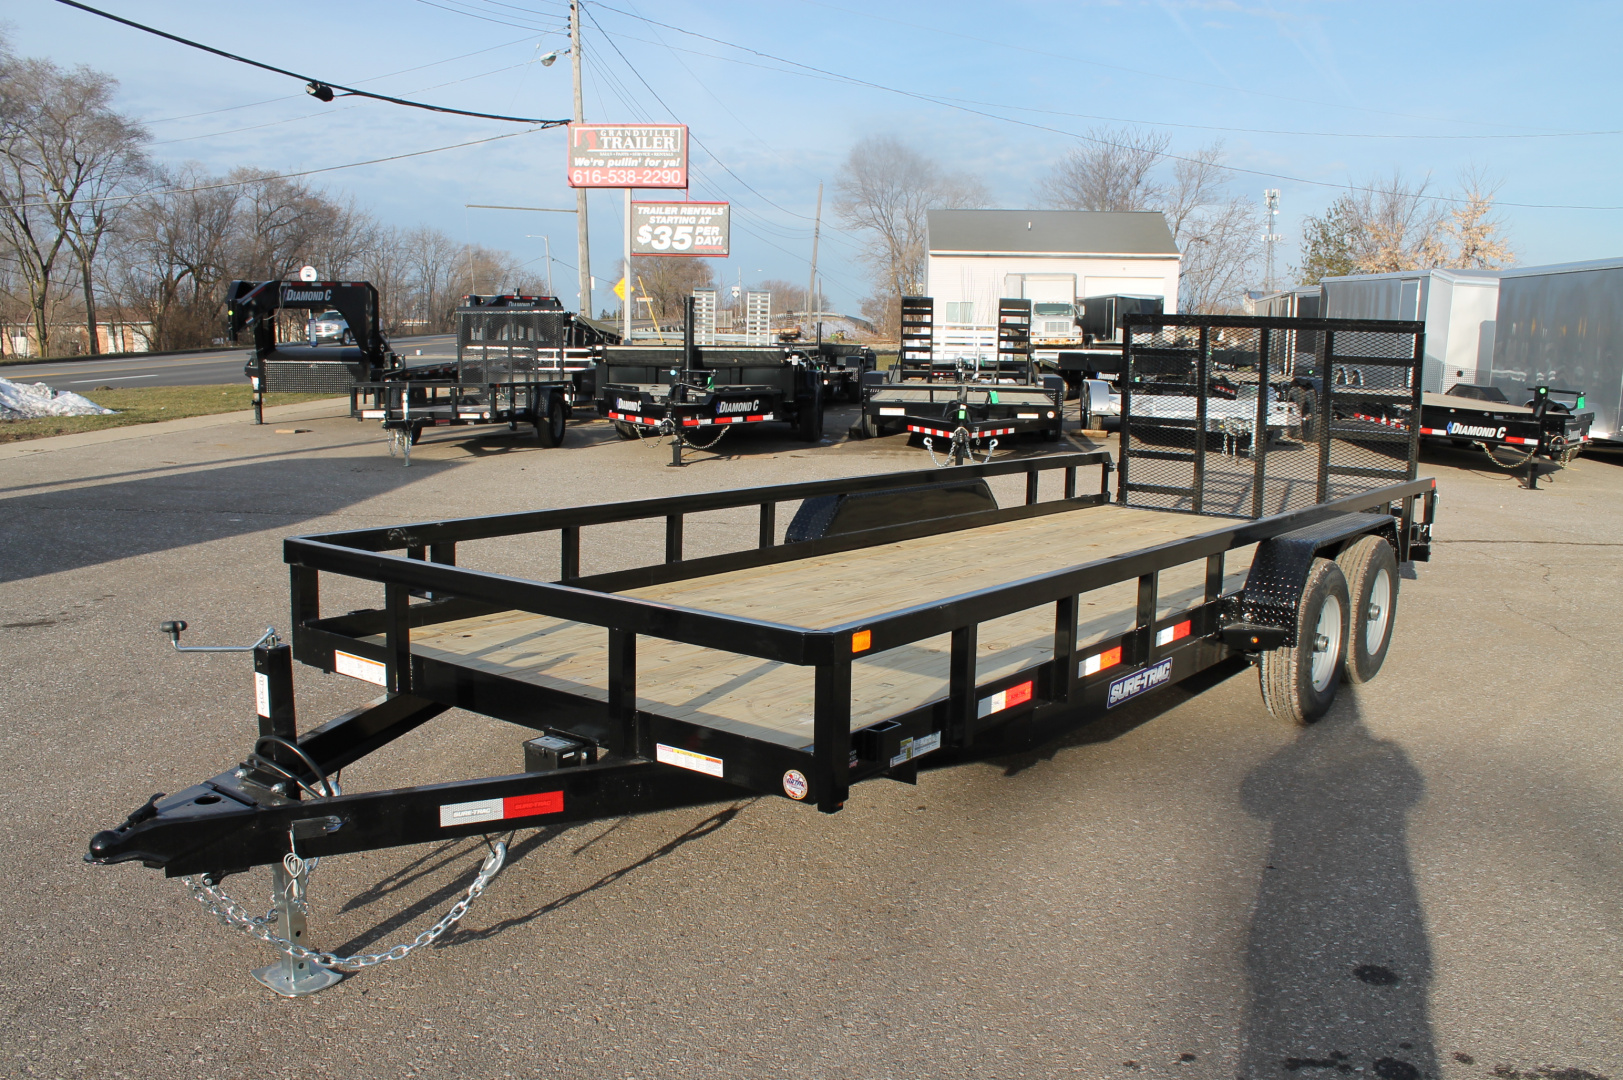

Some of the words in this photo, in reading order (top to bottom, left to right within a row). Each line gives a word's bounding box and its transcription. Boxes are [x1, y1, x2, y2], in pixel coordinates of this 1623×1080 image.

[600, 136, 675, 149] TRAILER
[574, 157, 605, 166] We're
[607, 157, 641, 168] pullin'
[645, 157, 660, 167] for
[663, 158, 681, 168] ya!
[573, 169, 681, 184] 616-538-2290
[637, 206, 678, 215] TRAILER
[680, 207, 724, 215] RENTALS
[649, 216, 696, 224] STARTING
[698, 216, 712, 224] AT
[636, 223, 694, 250] $35
[695, 226, 720, 236] PER
[694, 236, 723, 245] DAY!
[286, 289, 324, 301] DIAMOND
[325, 289, 332, 301] C
[618, 398, 637, 411] DIAMOND
[637, 400, 642, 412] C
[719, 401, 752, 413] DIAMOND
[752, 399, 759, 411] C
[1451, 422, 1496, 437] DIAMOND
[1496, 427, 1507, 438] C
[1110, 663, 1170, 704] SURE-TRAC
[453, 807, 491, 818] SURE-TRAC
